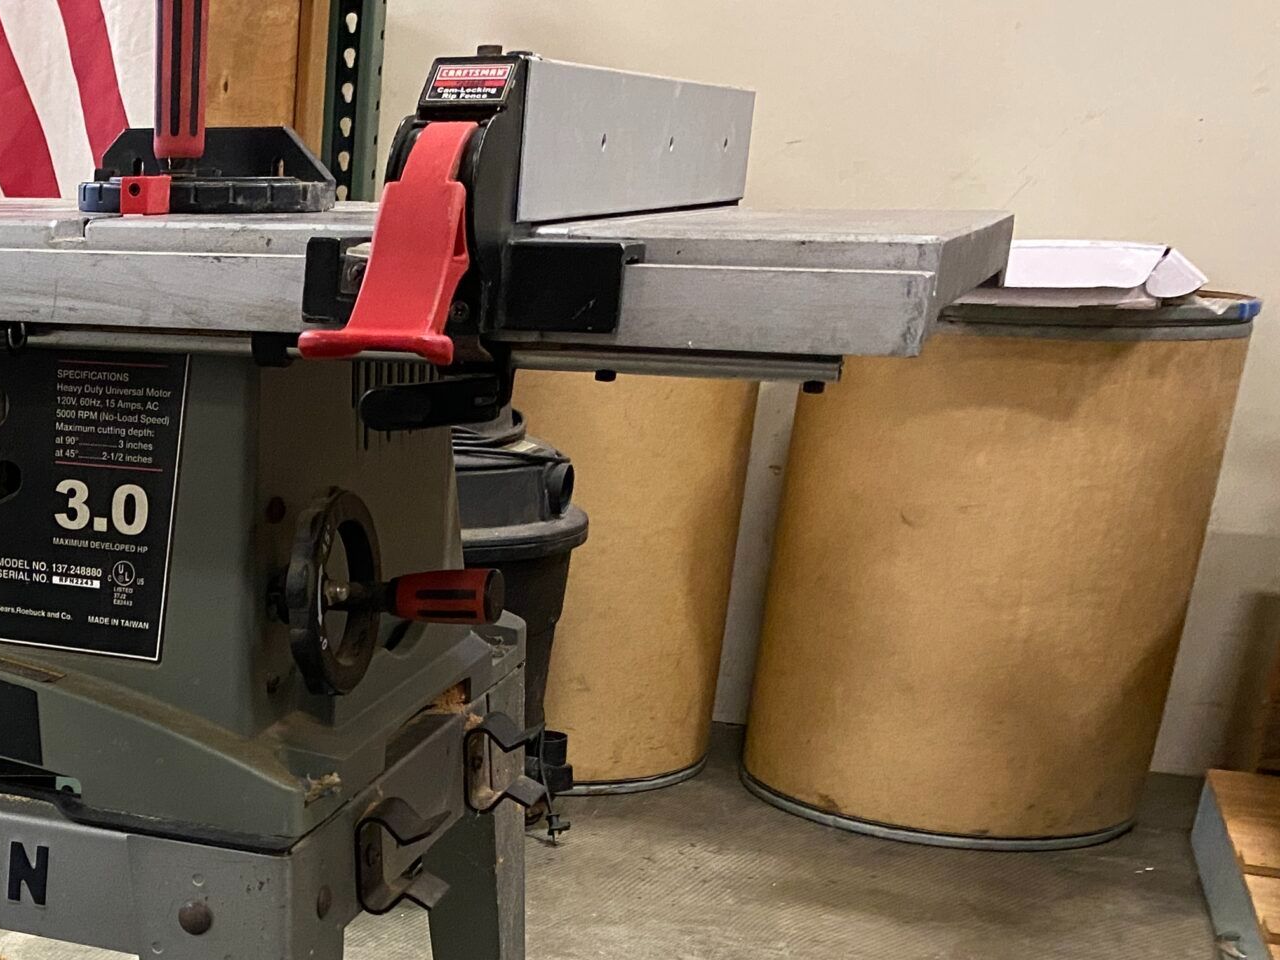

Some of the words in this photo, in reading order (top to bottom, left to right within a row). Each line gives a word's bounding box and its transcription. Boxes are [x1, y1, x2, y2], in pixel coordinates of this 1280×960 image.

[441, 68, 505, 77] CRAFTSMAN
[56, 369, 129, 382] SPECIFICATIONS
[56, 383, 82, 393] Heavy
[84, 384, 103, 396] Duty
[105, 386, 144, 396] Universal
[146, 388, 171, 398] Motor
[105, 399, 115, 408] 15
[117, 400, 144, 411] Amps,
[145, 401, 159, 411] AC
[56, 409, 76, 419] 5000
[77, 410, 98, 420] RPM
[99, 412, 138, 423] (No-Load
[140, 413, 170, 426] Speed)
[55, 422, 95, 433] Maximum
[97, 426, 126, 437] cutting
[55, 436, 64, 444] at
[126, 441, 153, 451] inches
[55, 449, 64, 457] at
[102, 451, 124, 462] 2-1/2
[125, 454, 153, 464] inches
[54, 479, 149, 535] 3.0
[52, 537, 89, 548] MAXIMUM
[90, 540, 136, 553] DEVELOPED
[137, 545, 149, 554] HP
[32, 560, 49, 572] NO.
[52, 563, 102, 578] 137.248880
[32, 573, 50, 584] NO.
[113, 586, 134, 594] LISTED
[46, 610, 60, 619] and
[61, 612, 73, 620] Co.
[88, 615, 109, 625] MADE
[110, 617, 119, 626] IN
[120, 619, 149, 630] TAIWAN
